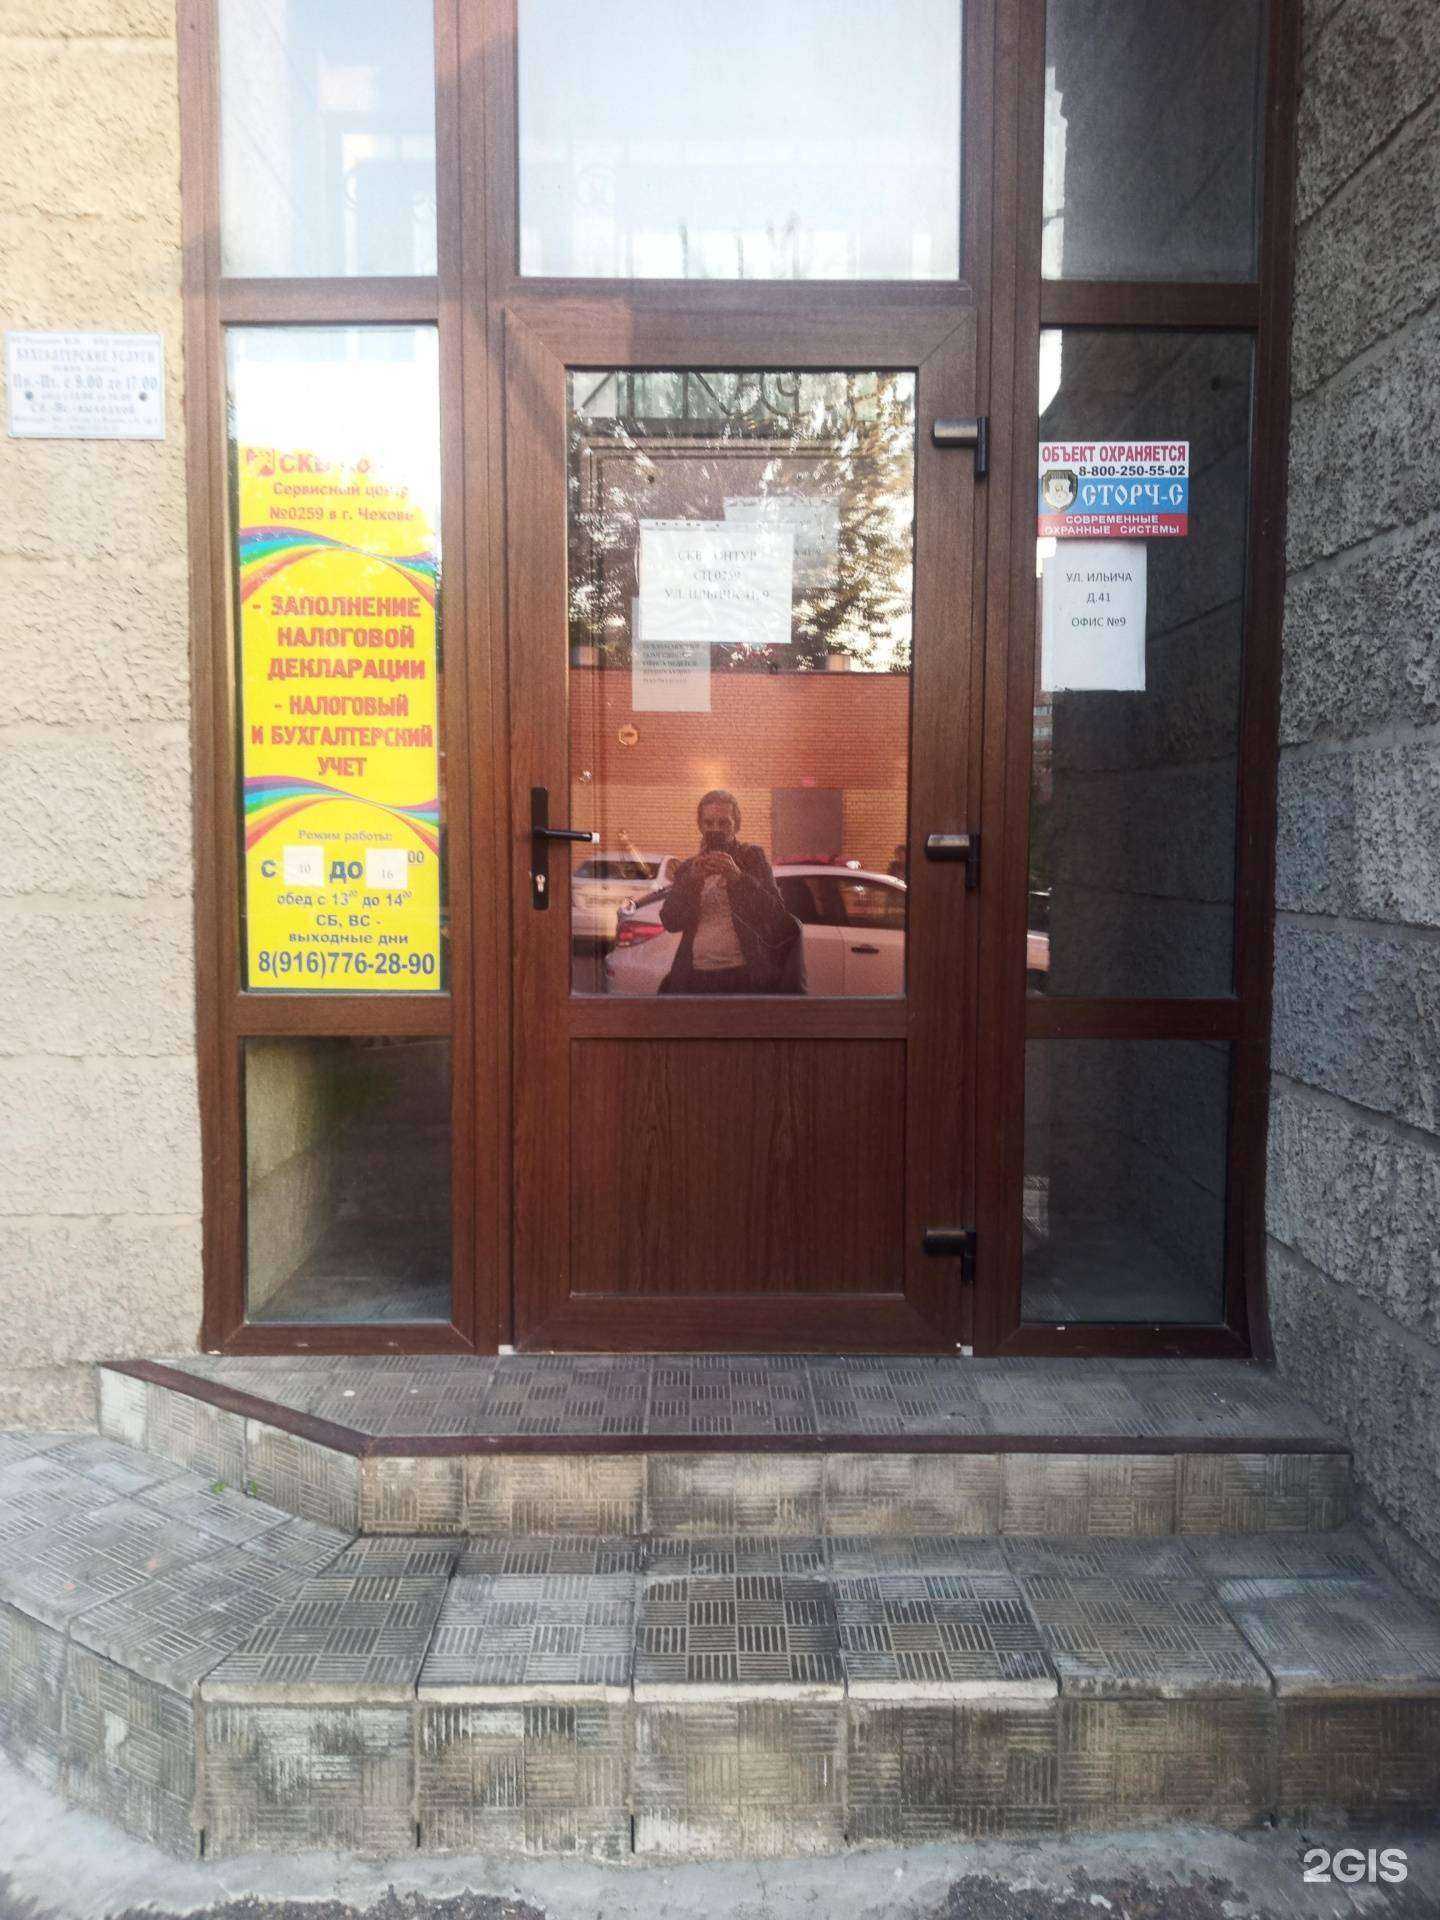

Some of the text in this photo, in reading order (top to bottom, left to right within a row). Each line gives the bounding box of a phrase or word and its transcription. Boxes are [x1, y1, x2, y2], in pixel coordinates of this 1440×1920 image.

[1043, 445, 1186, 463] ОБЪЕКТ ОХРАНЯЕТСЯ
[1078, 465, 1186, 477] 8-800-250-55-02
[273, 481, 361, 499] Сервисный
[1081, 483, 1184, 507] СТОРЧ-С
[1065, 514, 1160, 524] СОВРЕМЕННЫЕ
[1044, 525, 1179, 535] ОХРАННЫЕ СИСТЕМЫ
[1066, 571, 1133, 583] УЛ. ИЛЬИЧА
[271, 595, 421, 618] ЗАПОЛНЕНИЕ
[1086, 592, 1111, 604] Д.41
[1071, 617, 1126, 628] ОФИС №9
[277, 625, 415, 649] НАЛОГОВОЙ
[267, 658, 426, 682] ДЕКЛАРАЦИИ
[289, 694, 409, 717] НАЛОГОВЫЙ
[251, 724, 433, 748] И БУХГАЛТЕРСКИЙ
[317, 756, 367, 777] УЧЕТ
[298, 830, 341, 841] Режим
[276, 892, 313, 907] обед
[362, 896, 380, 908] до
[316, 914, 344, 928] СБ,
[348, 914, 371, 927] ВС
[288, 932, 408, 946] выходные дни
[258, 950, 435, 978] 8(916)776-28-90
